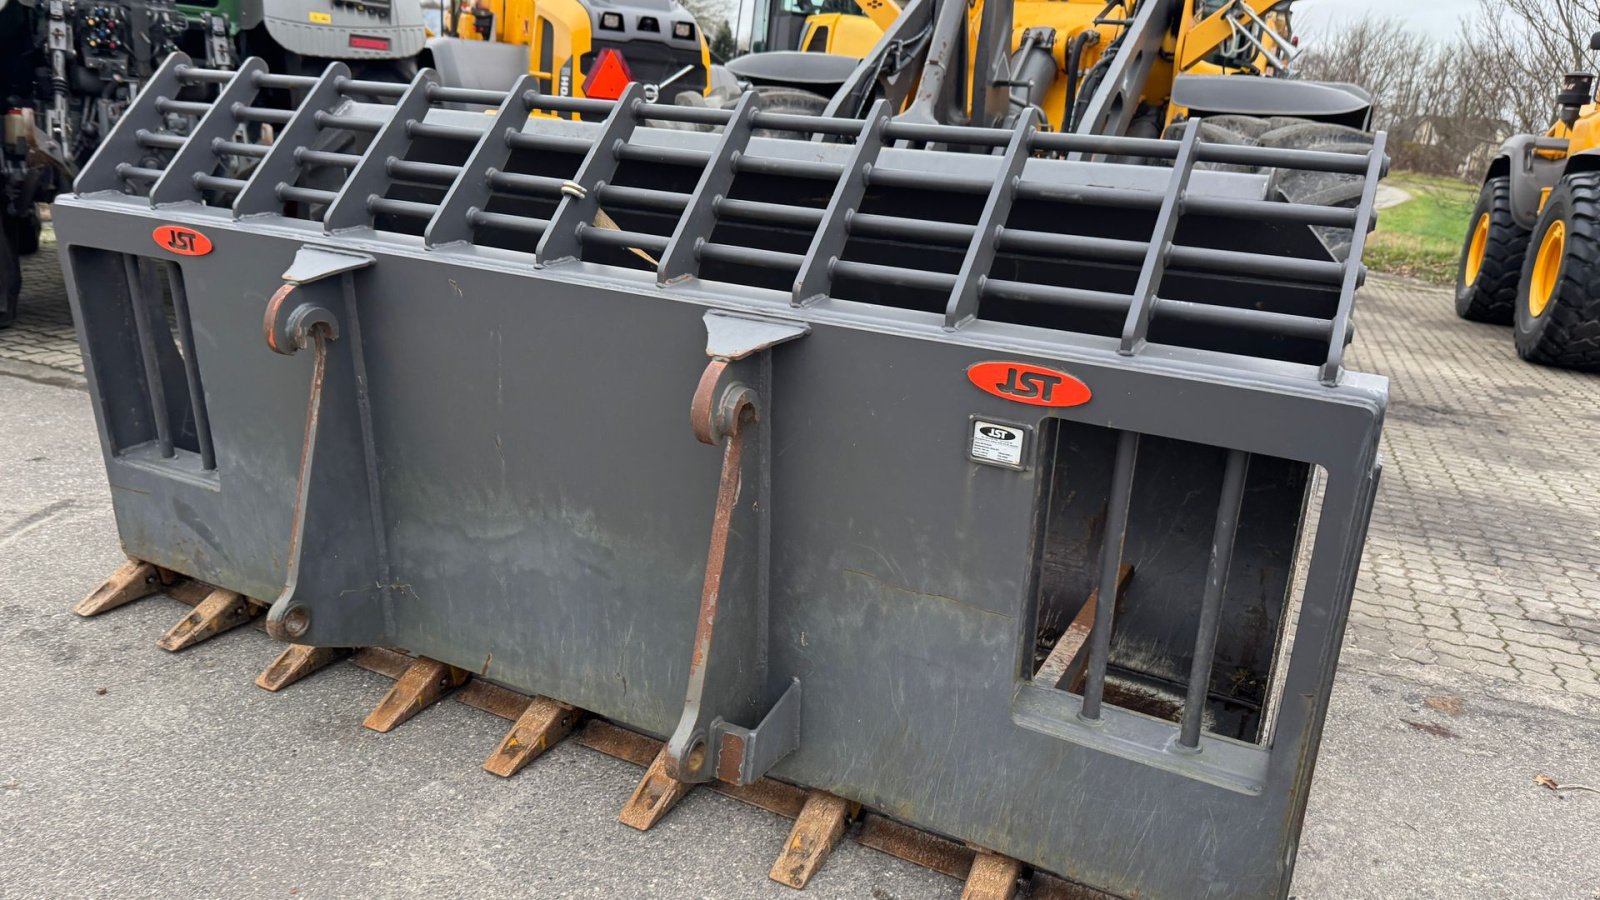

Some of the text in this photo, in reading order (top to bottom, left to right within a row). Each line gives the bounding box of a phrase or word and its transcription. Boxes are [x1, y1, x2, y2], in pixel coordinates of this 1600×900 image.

[168, 230, 196, 252] JST
[996, 368, 1062, 401] JST
[988, 428, 1008, 439] JST
